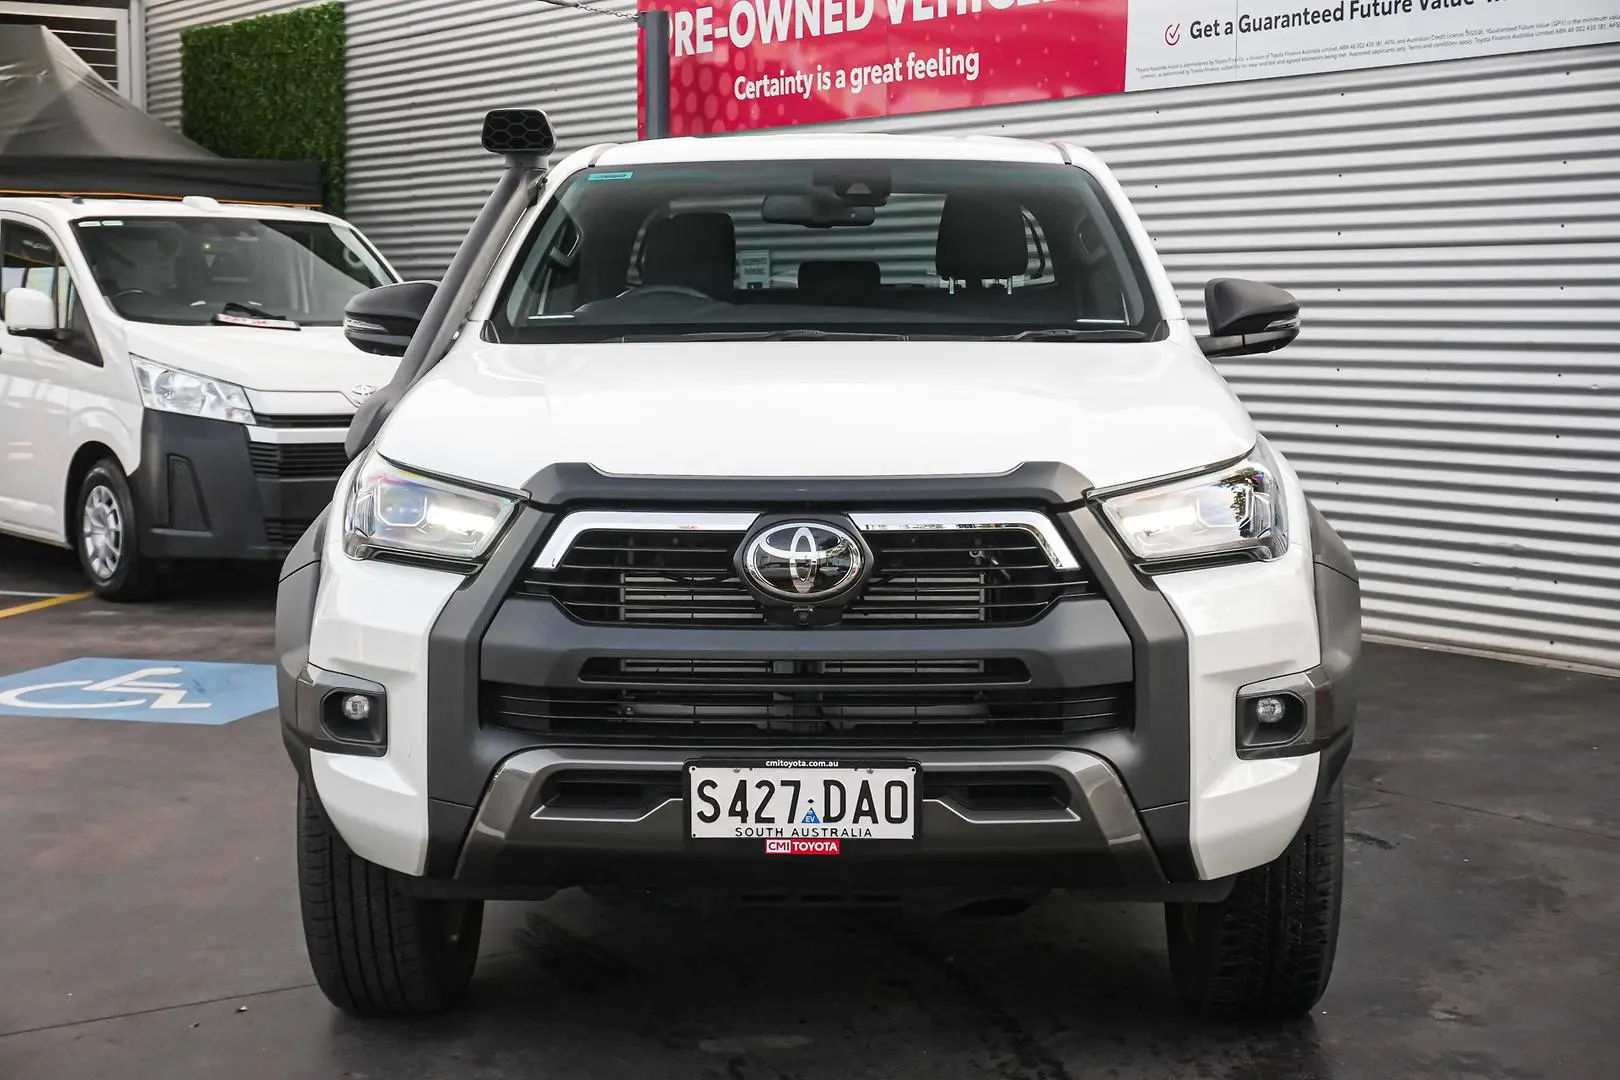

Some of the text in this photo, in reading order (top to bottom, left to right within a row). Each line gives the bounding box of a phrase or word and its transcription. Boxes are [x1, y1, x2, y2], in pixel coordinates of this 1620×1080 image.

[669, 0, 875, 57] RE-OWNED
[1190, 19, 1220, 39] Get
[1225, 21, 1234, 36] a
[1238, 1, 1344, 34] Guaranteed
[1350, 0, 1412, 20] Future
[734, 47, 980, 100] Certainty is a great feeling
[765, 759, 839, 769] cmitoyota.com.au
[696, 779, 909, 824] S427 DAO
[805, 815, 815, 823] EV
[735, 827, 873, 838] SOUTH AUSTRALIA
[768, 841, 838, 852] CMI TOYOTA
